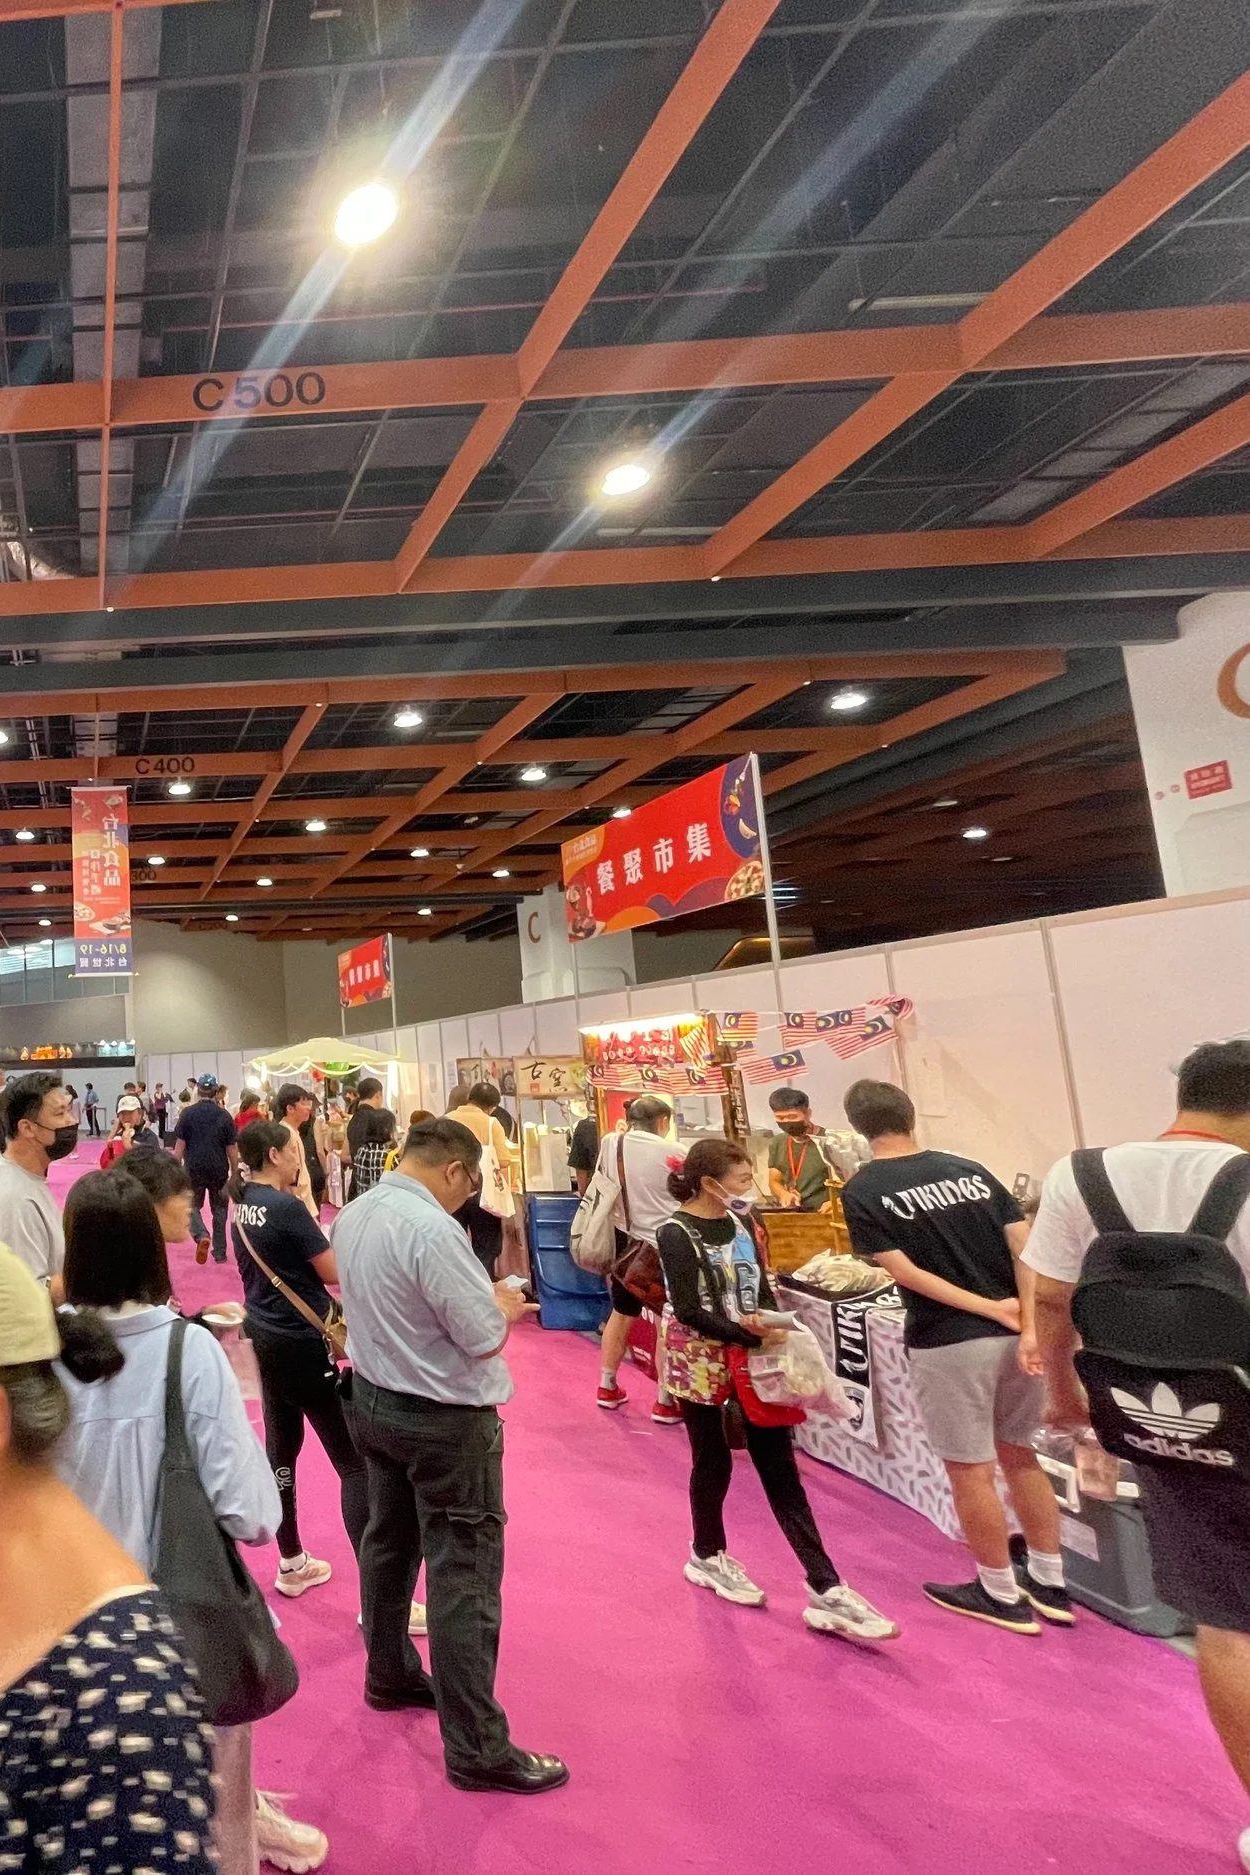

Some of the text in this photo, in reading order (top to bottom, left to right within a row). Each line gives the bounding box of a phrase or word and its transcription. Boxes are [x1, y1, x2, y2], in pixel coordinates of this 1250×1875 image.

[596, 822, 711, 895] 餐聚市集
[528, 911, 542, 944] C
[1123, 1432, 1234, 1466] adidas
